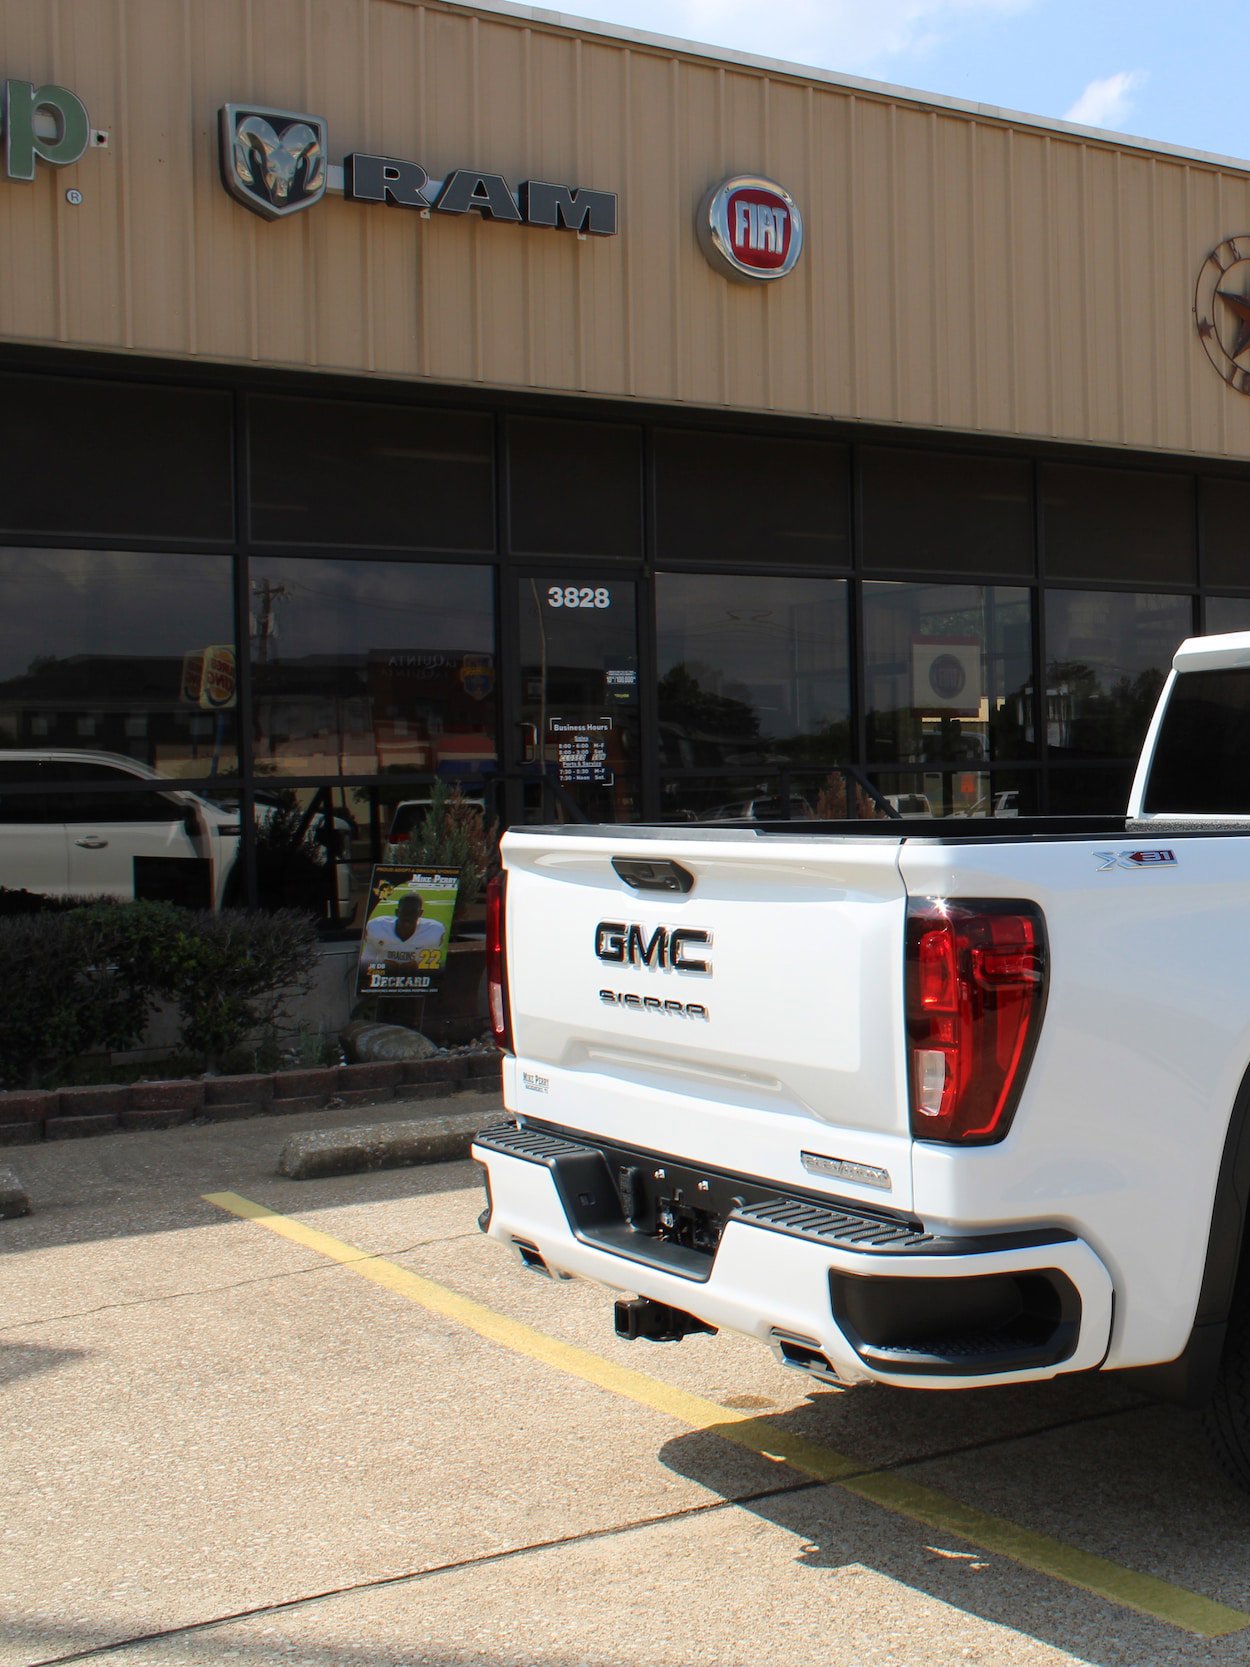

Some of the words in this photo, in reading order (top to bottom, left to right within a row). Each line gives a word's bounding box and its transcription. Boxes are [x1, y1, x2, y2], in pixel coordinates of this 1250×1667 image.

[0, 78, 90, 184] p
[343, 152, 618, 237] RAM
[735, 200, 787, 255] FIAT
[548, 586, 610, 608] 3828
[553, 723, 586, 731] Business
[587, 723, 609, 731] Hours
[1091, 850, 1177, 872] X31
[387, 950, 417, 960] DRAGONS
[595, 920, 713, 976] GMC
[418, 950, 441, 969] 22
[370, 974, 430, 987] DECKARD
[599, 989, 710, 1021] SIERRA
